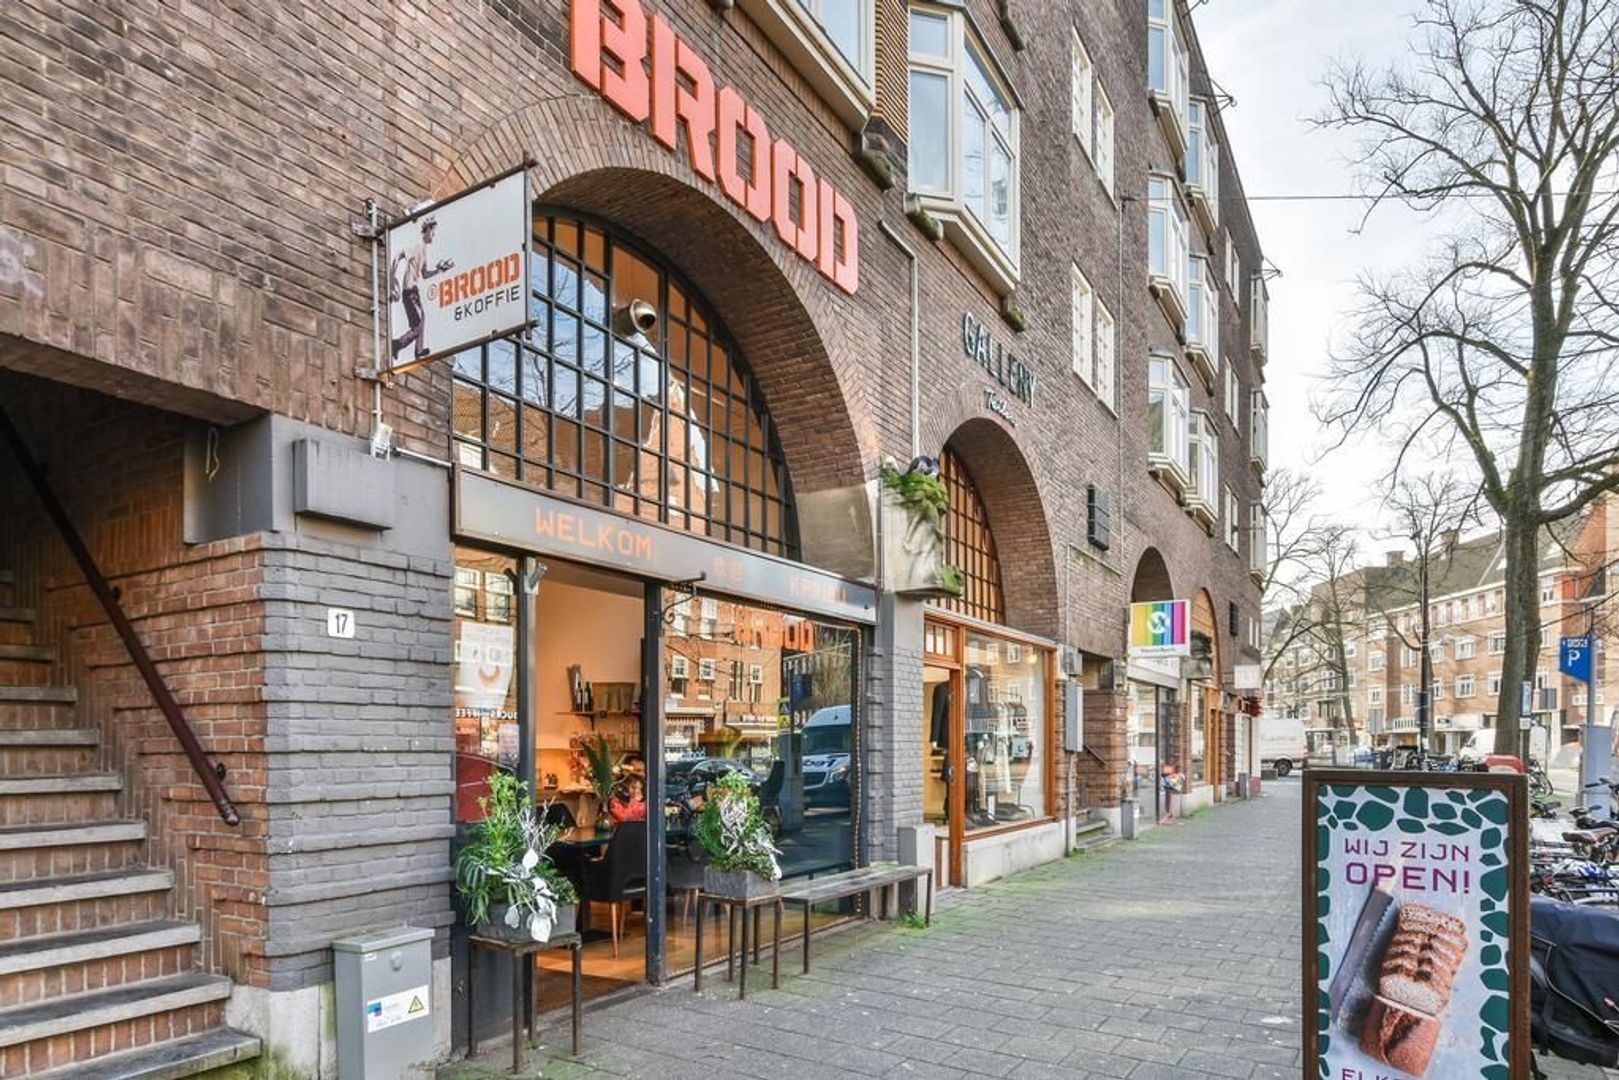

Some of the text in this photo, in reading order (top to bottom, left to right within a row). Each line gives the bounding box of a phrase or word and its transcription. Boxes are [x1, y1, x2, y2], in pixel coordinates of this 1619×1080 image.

[568, 0, 858, 296] BROOD
[439, 253, 520, 308] BROOD
[454, 284, 520, 321] &KOFFIE
[962, 311, 1037, 410] GALLERY
[534, 505, 654, 560] WELKOM
[335, 612, 348, 634] 17
[1568, 649, 1581, 667] P
[1344, 838, 1469, 862] WIJ ZIJN
[1346, 862, 1470, 894] OPEN!
